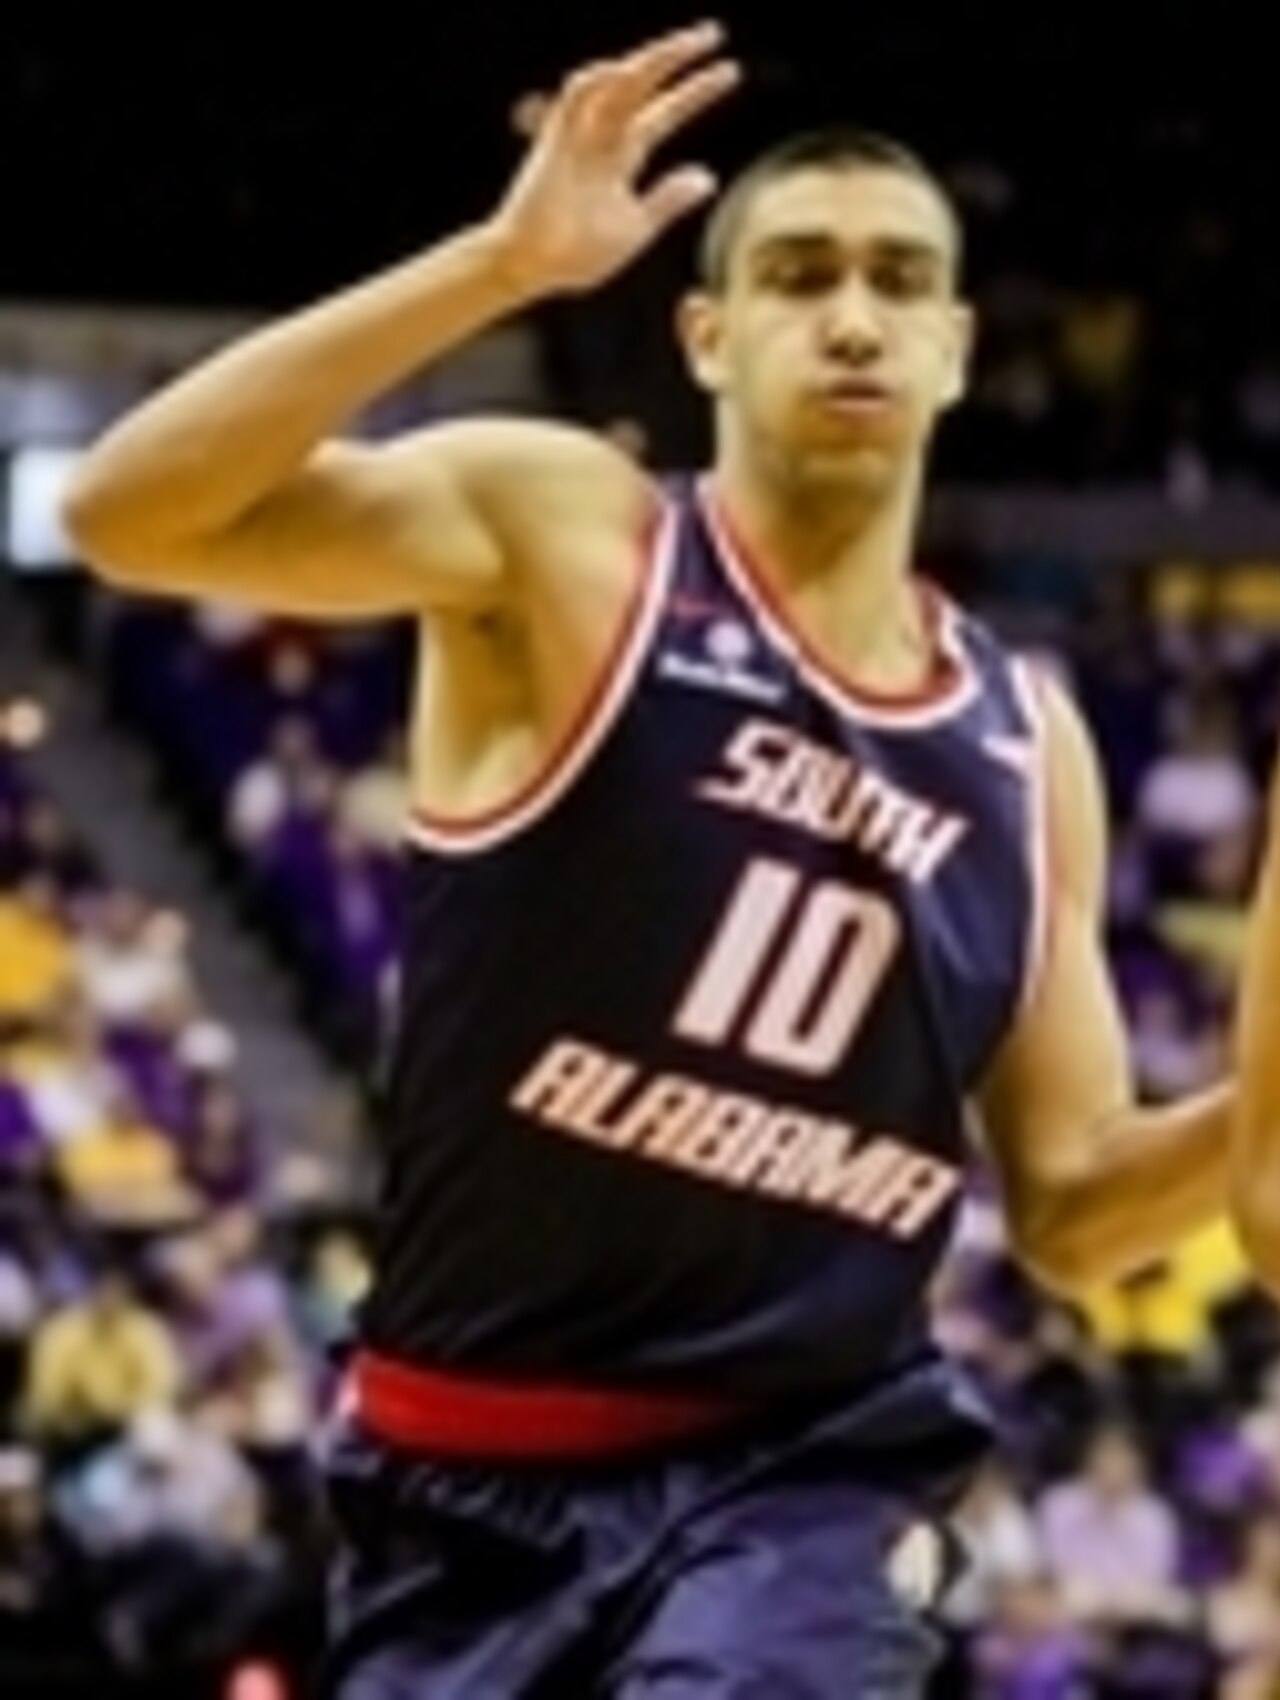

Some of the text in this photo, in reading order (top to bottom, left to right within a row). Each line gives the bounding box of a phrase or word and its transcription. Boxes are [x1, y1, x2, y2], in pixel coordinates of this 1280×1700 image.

[699, 717, 967, 884] SOUTH
[671, 857, 900, 1077] 10
[510, 1037, 962, 1239] ALABAMA
